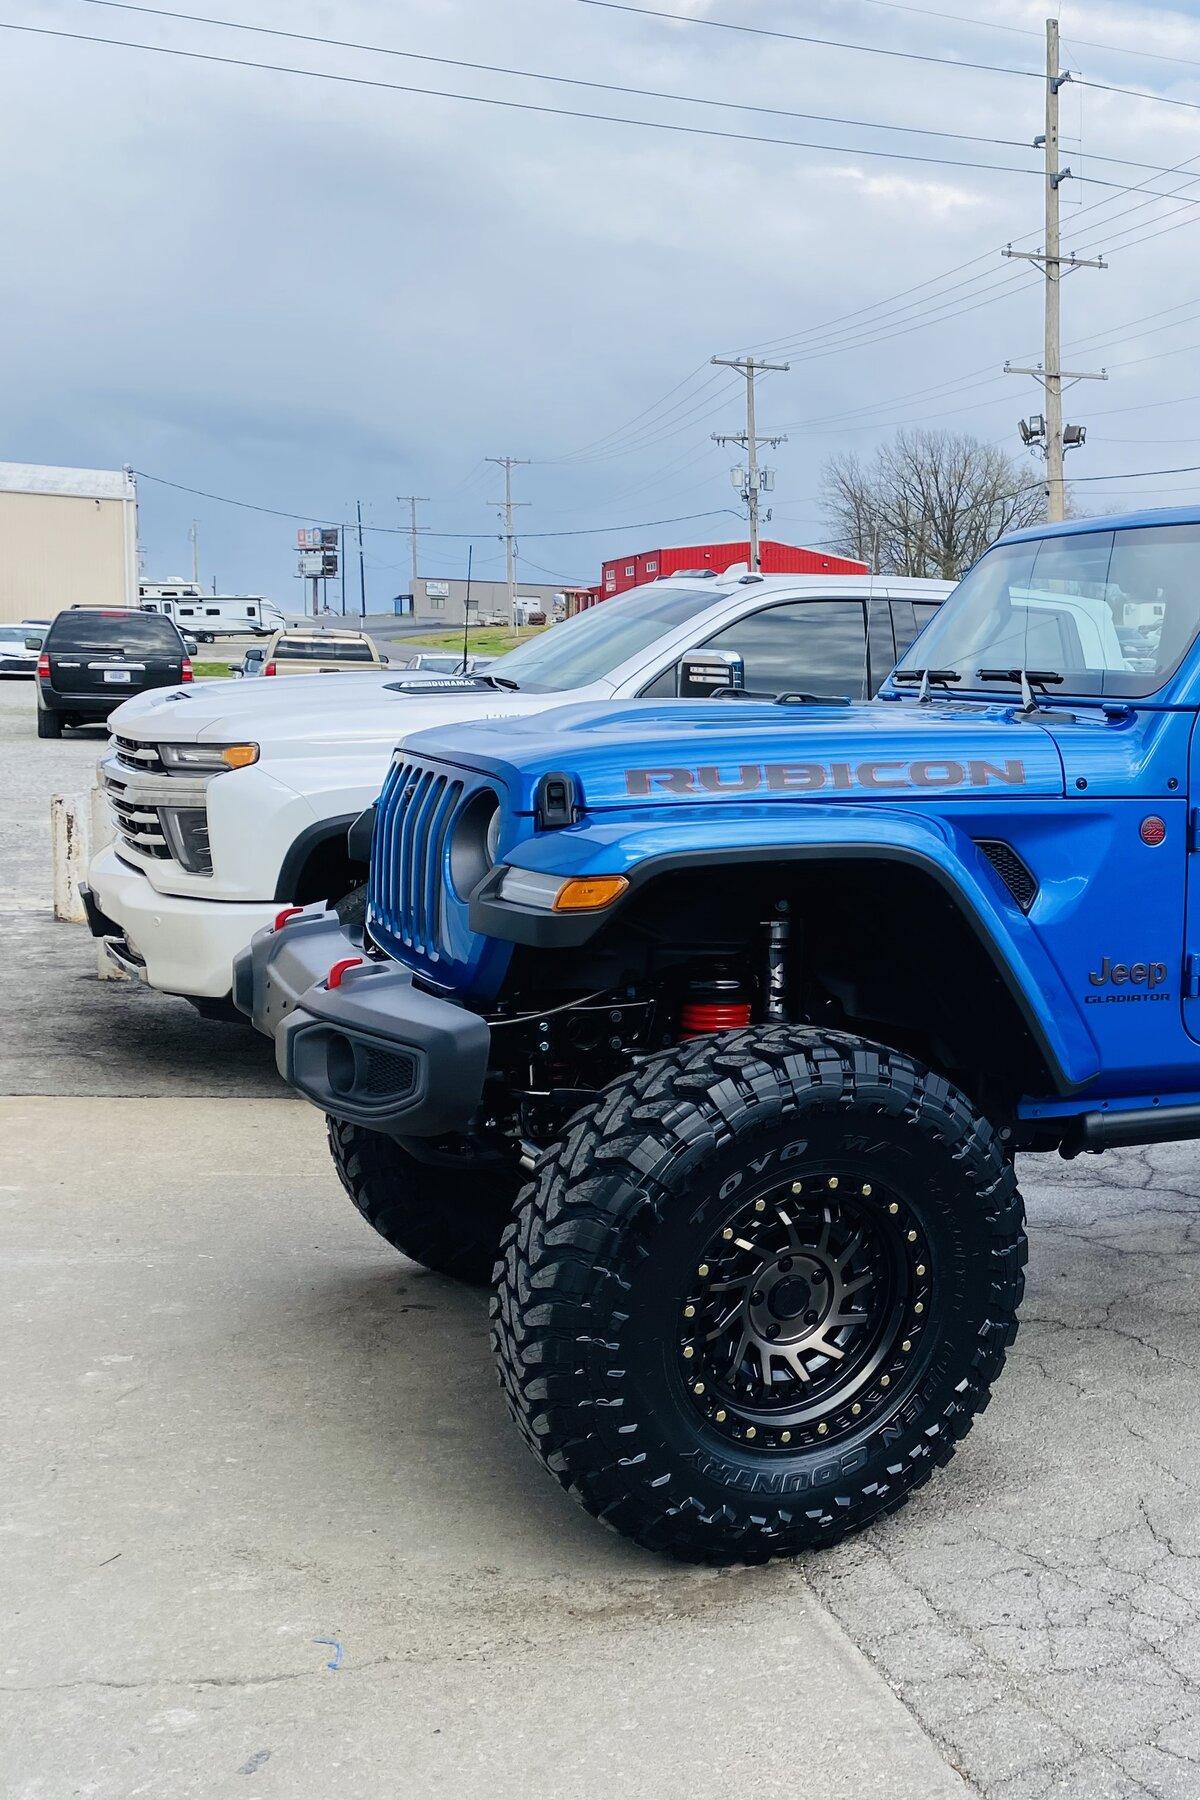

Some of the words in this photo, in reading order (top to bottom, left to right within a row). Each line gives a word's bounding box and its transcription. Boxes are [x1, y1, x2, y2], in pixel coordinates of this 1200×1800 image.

[625, 760, 1026, 795] RUBICON
[1088, 956, 1167, 990] Jeep
[1084, 993, 1170, 1004] GLADIATOR
[679, 1446, 868, 1494] COUNTRY
